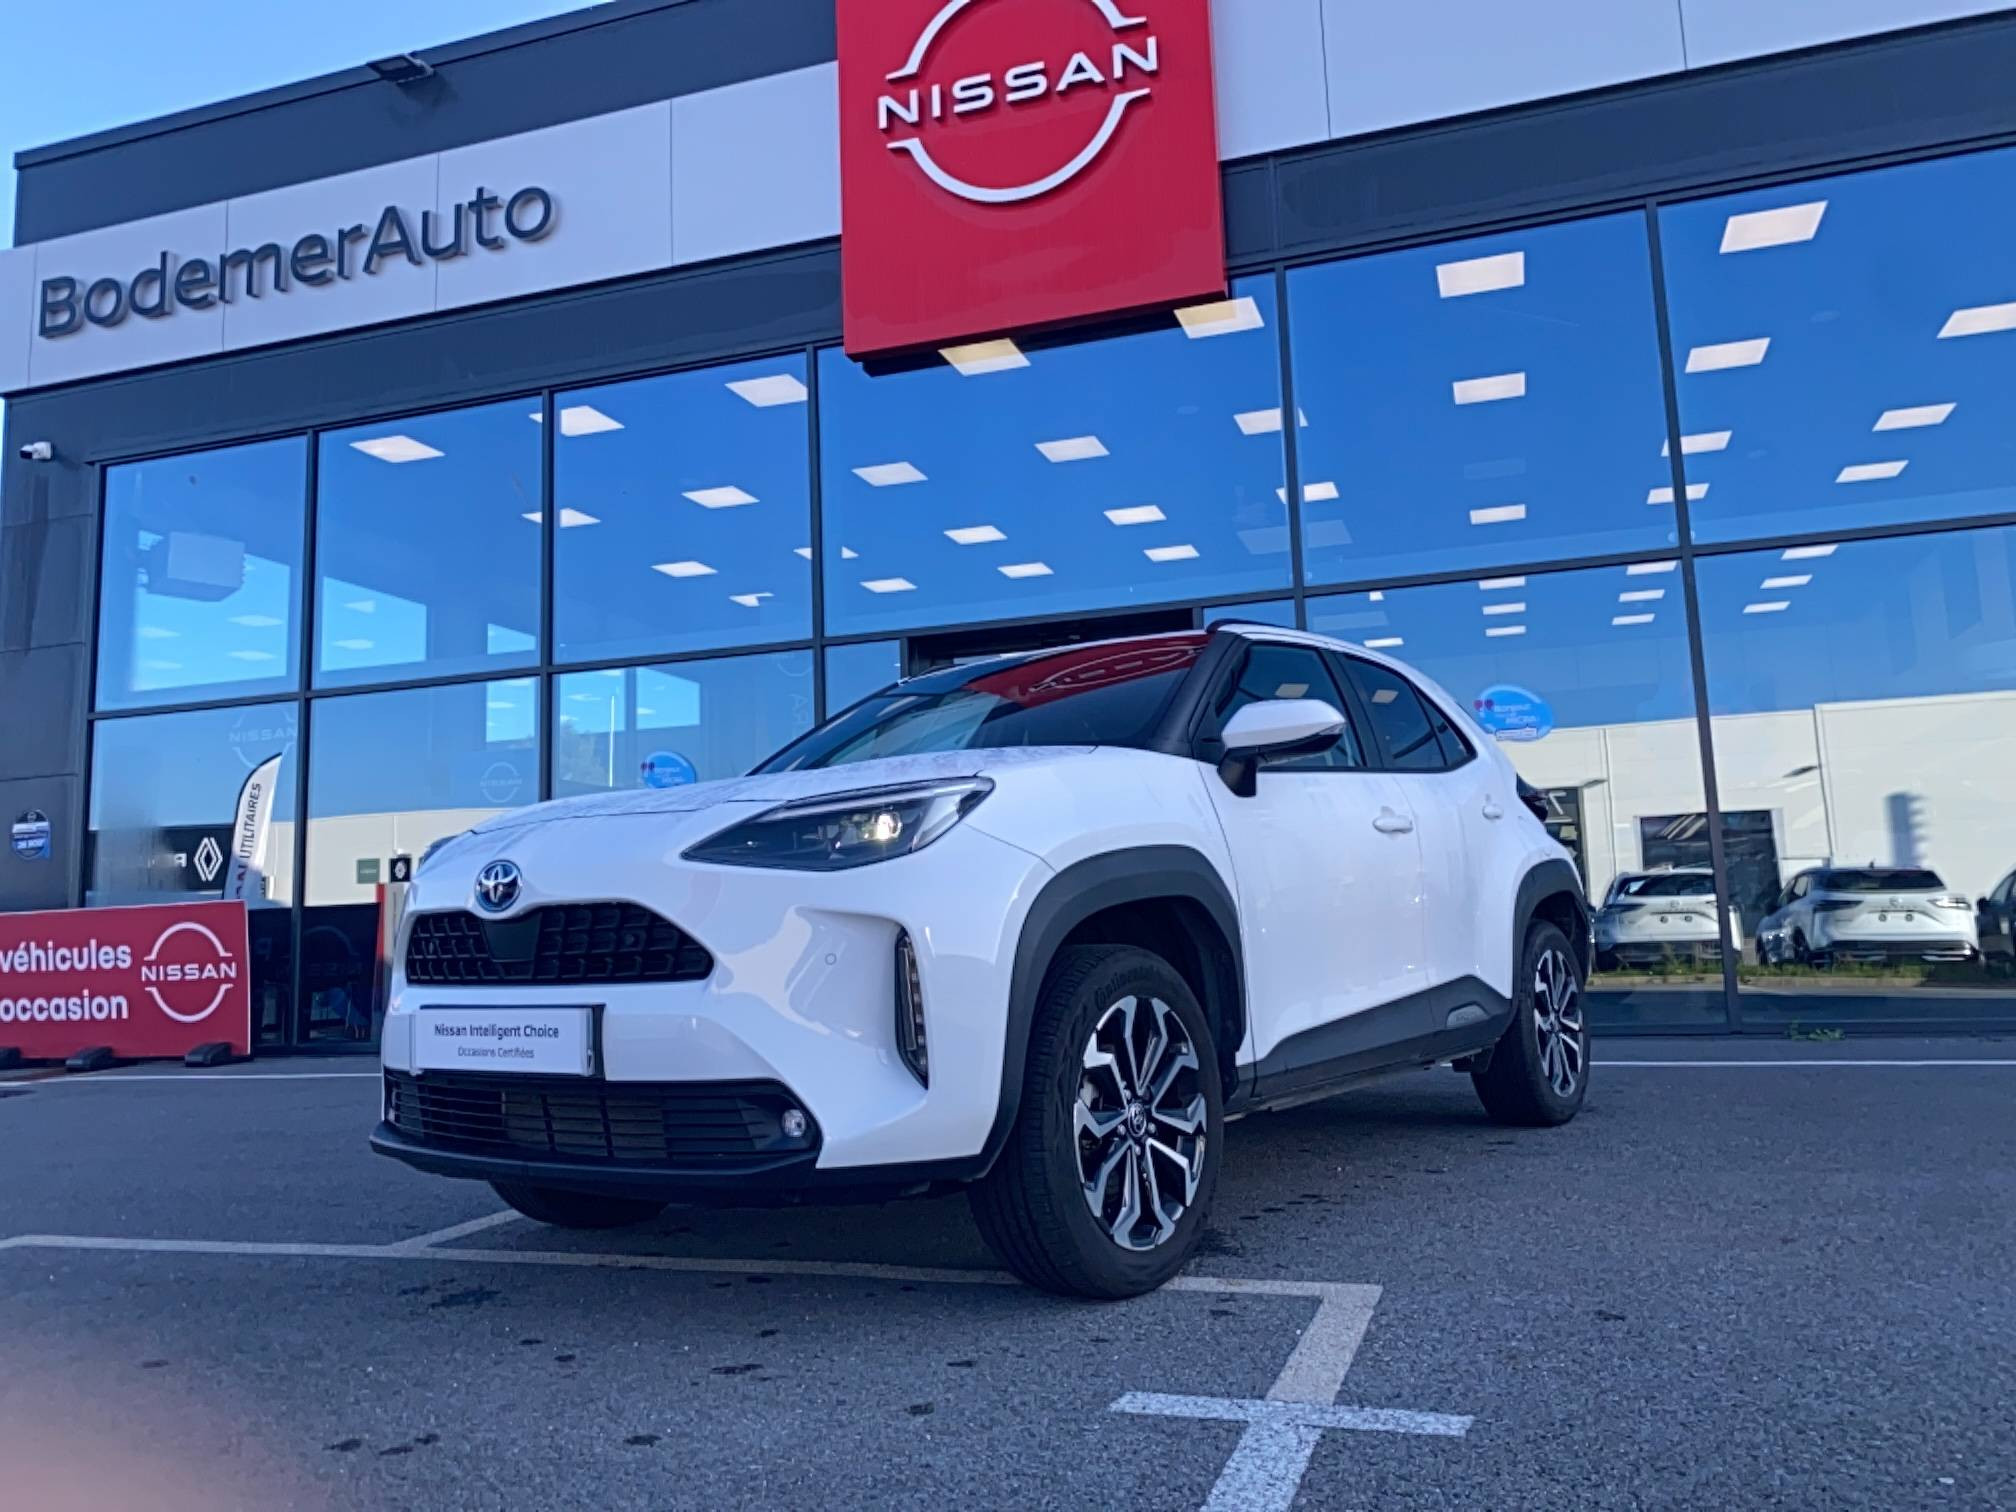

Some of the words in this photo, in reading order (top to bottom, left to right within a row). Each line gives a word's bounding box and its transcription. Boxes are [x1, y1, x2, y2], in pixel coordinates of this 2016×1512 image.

[878, 36, 1159, 130] NISSAN
[38, 185, 553, 338] BodemerAuto
[239, 783, 262, 860] UTILITAIRES
[0, 939, 132, 973] véhicules
[141, 962, 238, 982] NISSAN
[434, 1023, 467, 1036] Nissan
[470, 1023, 521, 1040] Intelligent
[524, 1025, 559, 1038] Choice
[458, 1046, 497, 1058] Occasions
